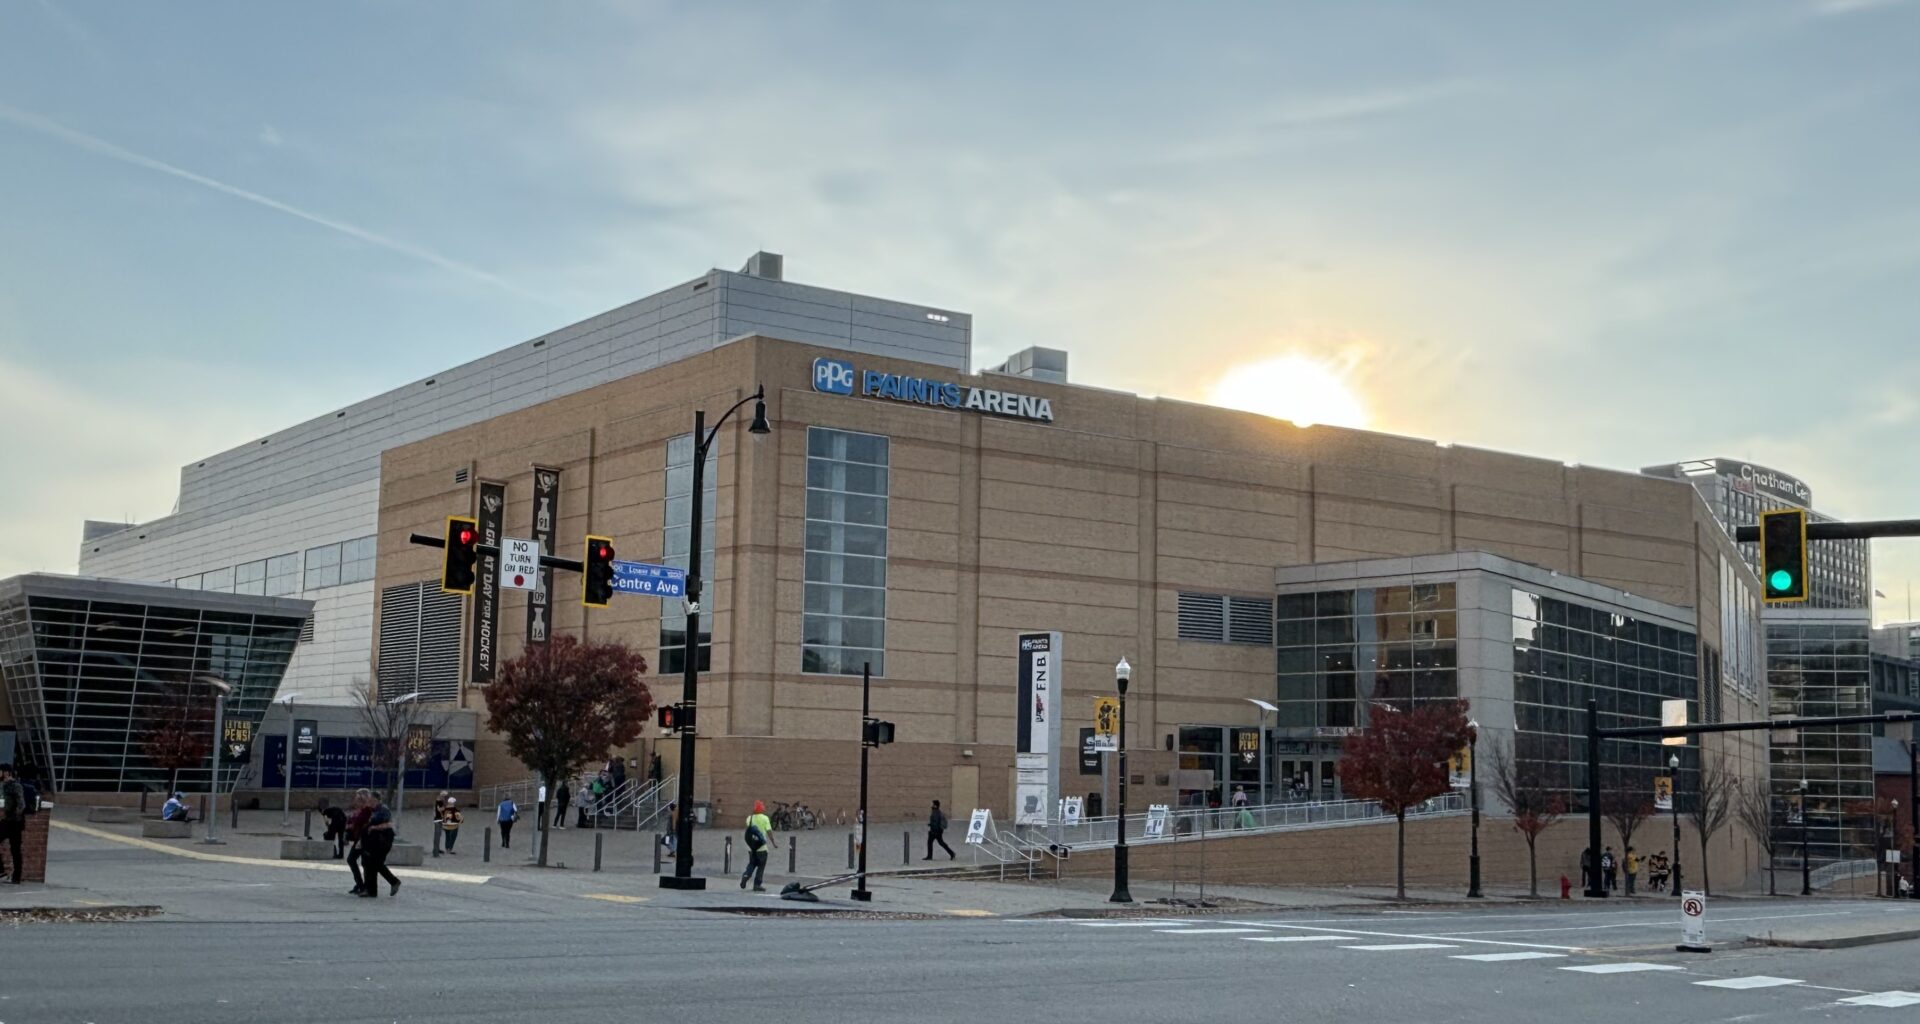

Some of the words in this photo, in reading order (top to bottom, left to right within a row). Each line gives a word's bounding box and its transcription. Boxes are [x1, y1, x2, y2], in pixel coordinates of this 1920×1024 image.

[817, 362, 853, 389] PPG
[863, 370, 960, 408] PAINTS
[967, 387, 1053, 420] ARENA
[1741, 465, 1793, 494] Chatham
[538, 517, 548, 529] 91
[484, 528, 496, 571] GRAT
[513, 541, 528, 552] NO
[510, 553, 532, 563] TURN
[504, 563, 516, 572] ON
[519, 565, 535, 574] RED
[482, 573, 494, 599] DAY
[608, 574, 652, 591] Centre
[656, 580, 679, 594] Ave
[534, 591, 544, 602] 09
[532, 628, 543, 639] 16
